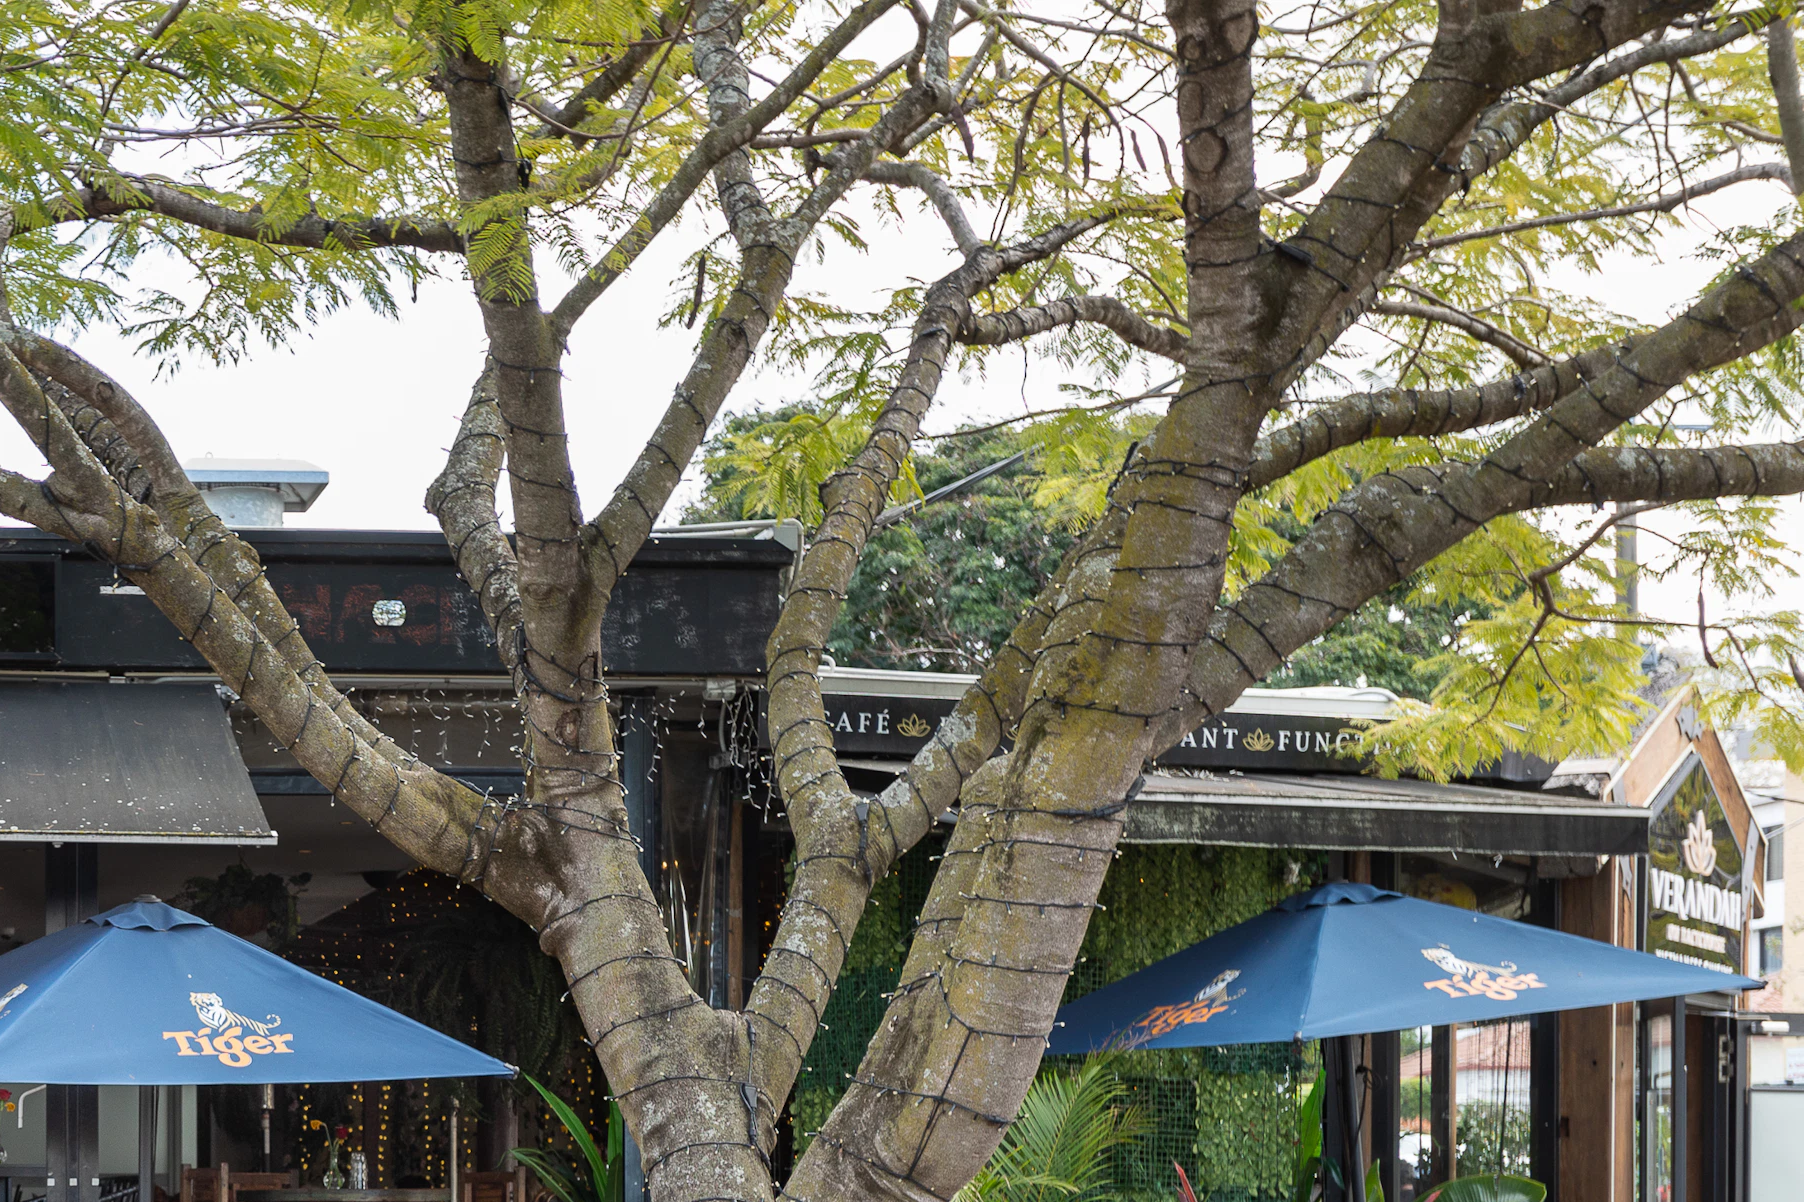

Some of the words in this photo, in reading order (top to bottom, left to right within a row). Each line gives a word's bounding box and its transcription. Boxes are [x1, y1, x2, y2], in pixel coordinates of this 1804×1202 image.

[1650, 868, 1741, 931] VERANDAH
[1423, 970, 1548, 1001] Tiger
[1135, 1000, 1230, 1035] Tiger
[162, 1026, 294, 1068] Tiger
